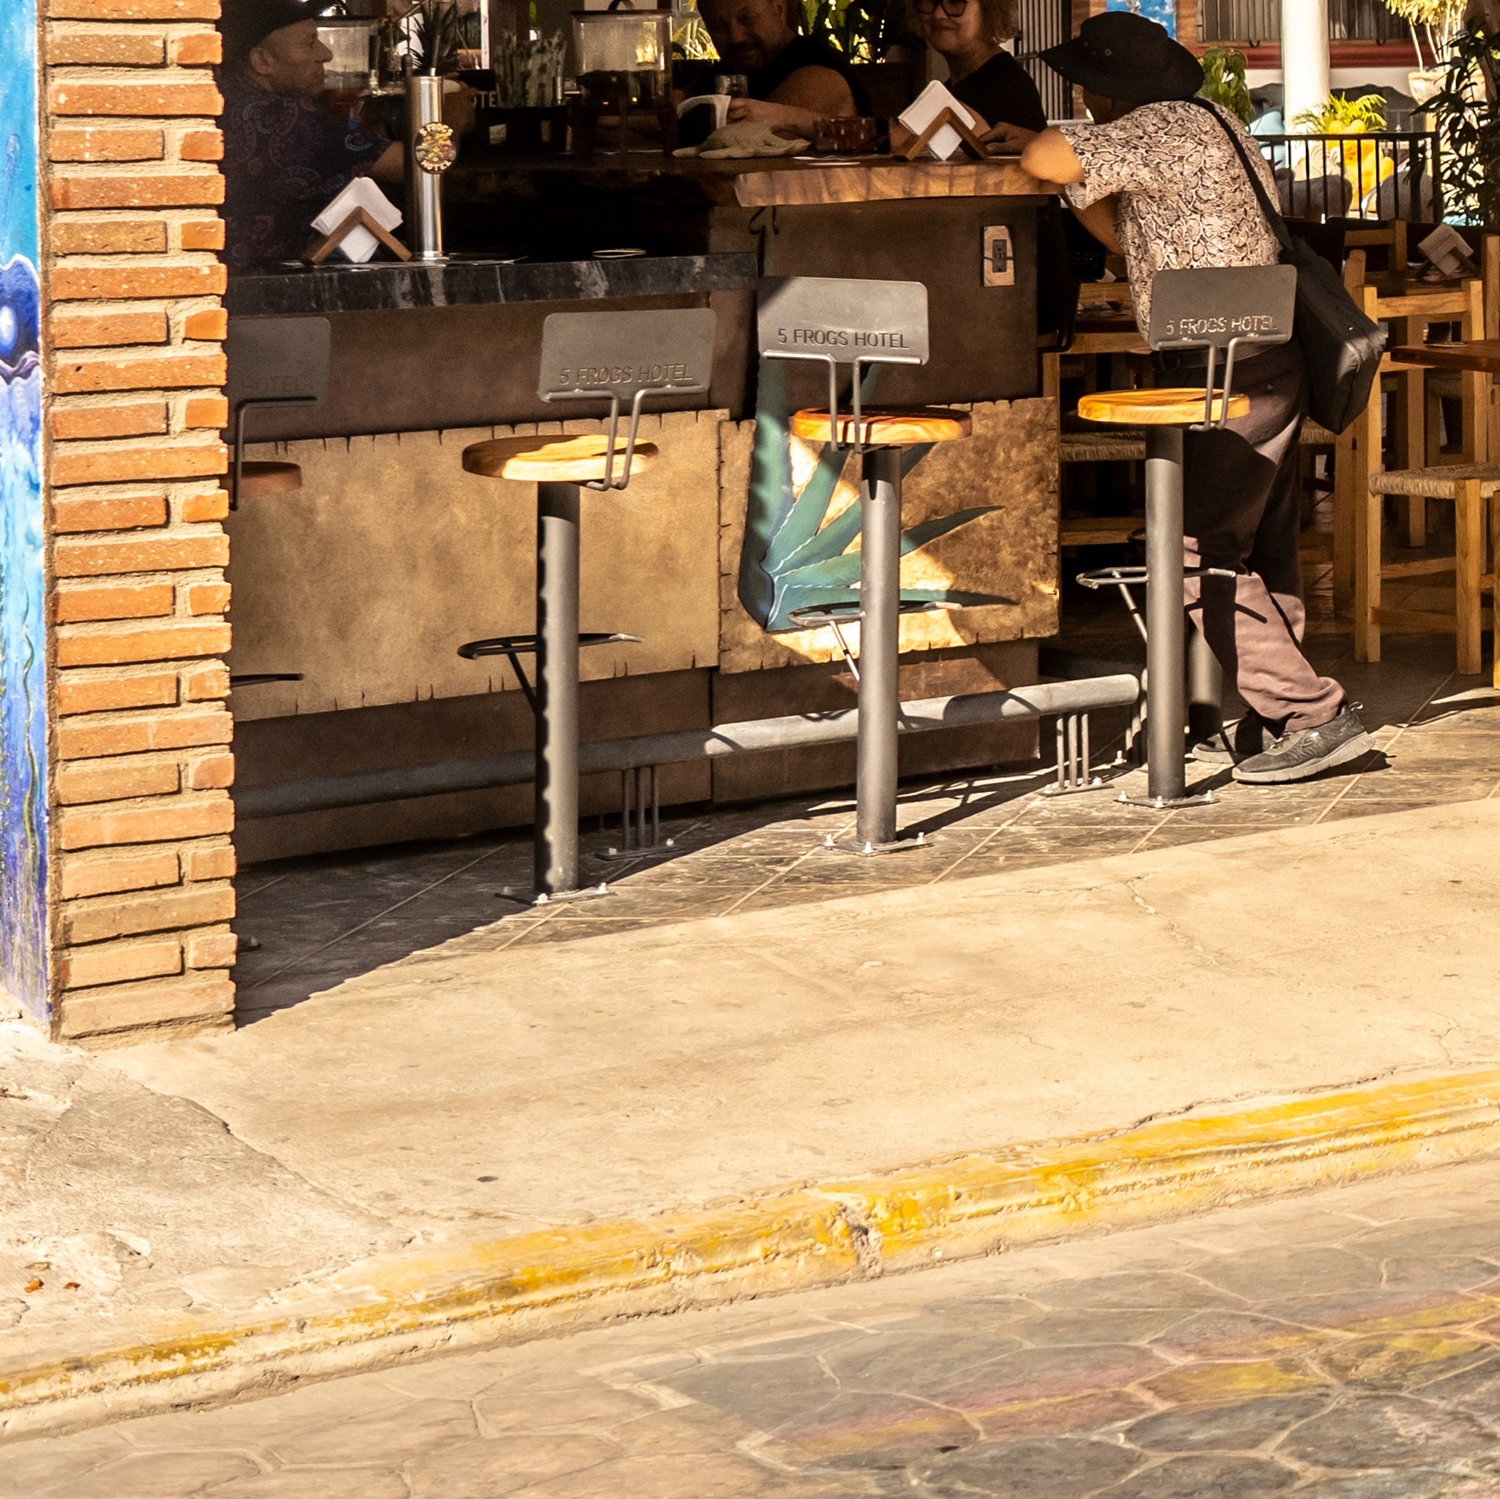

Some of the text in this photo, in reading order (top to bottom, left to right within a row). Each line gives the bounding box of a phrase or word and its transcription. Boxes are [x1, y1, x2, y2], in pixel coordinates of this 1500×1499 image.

[426, 123, 454, 136] FROGS
[421, 160, 452, 171] HOTEL
[1180, 317, 1227, 334] FROGS
[1231, 316, 1277, 332] HOTEL
[778, 329, 909, 349] 5 FROGS HOTEL
[560, 364, 693, 385] 5 FROGS HOTEL
